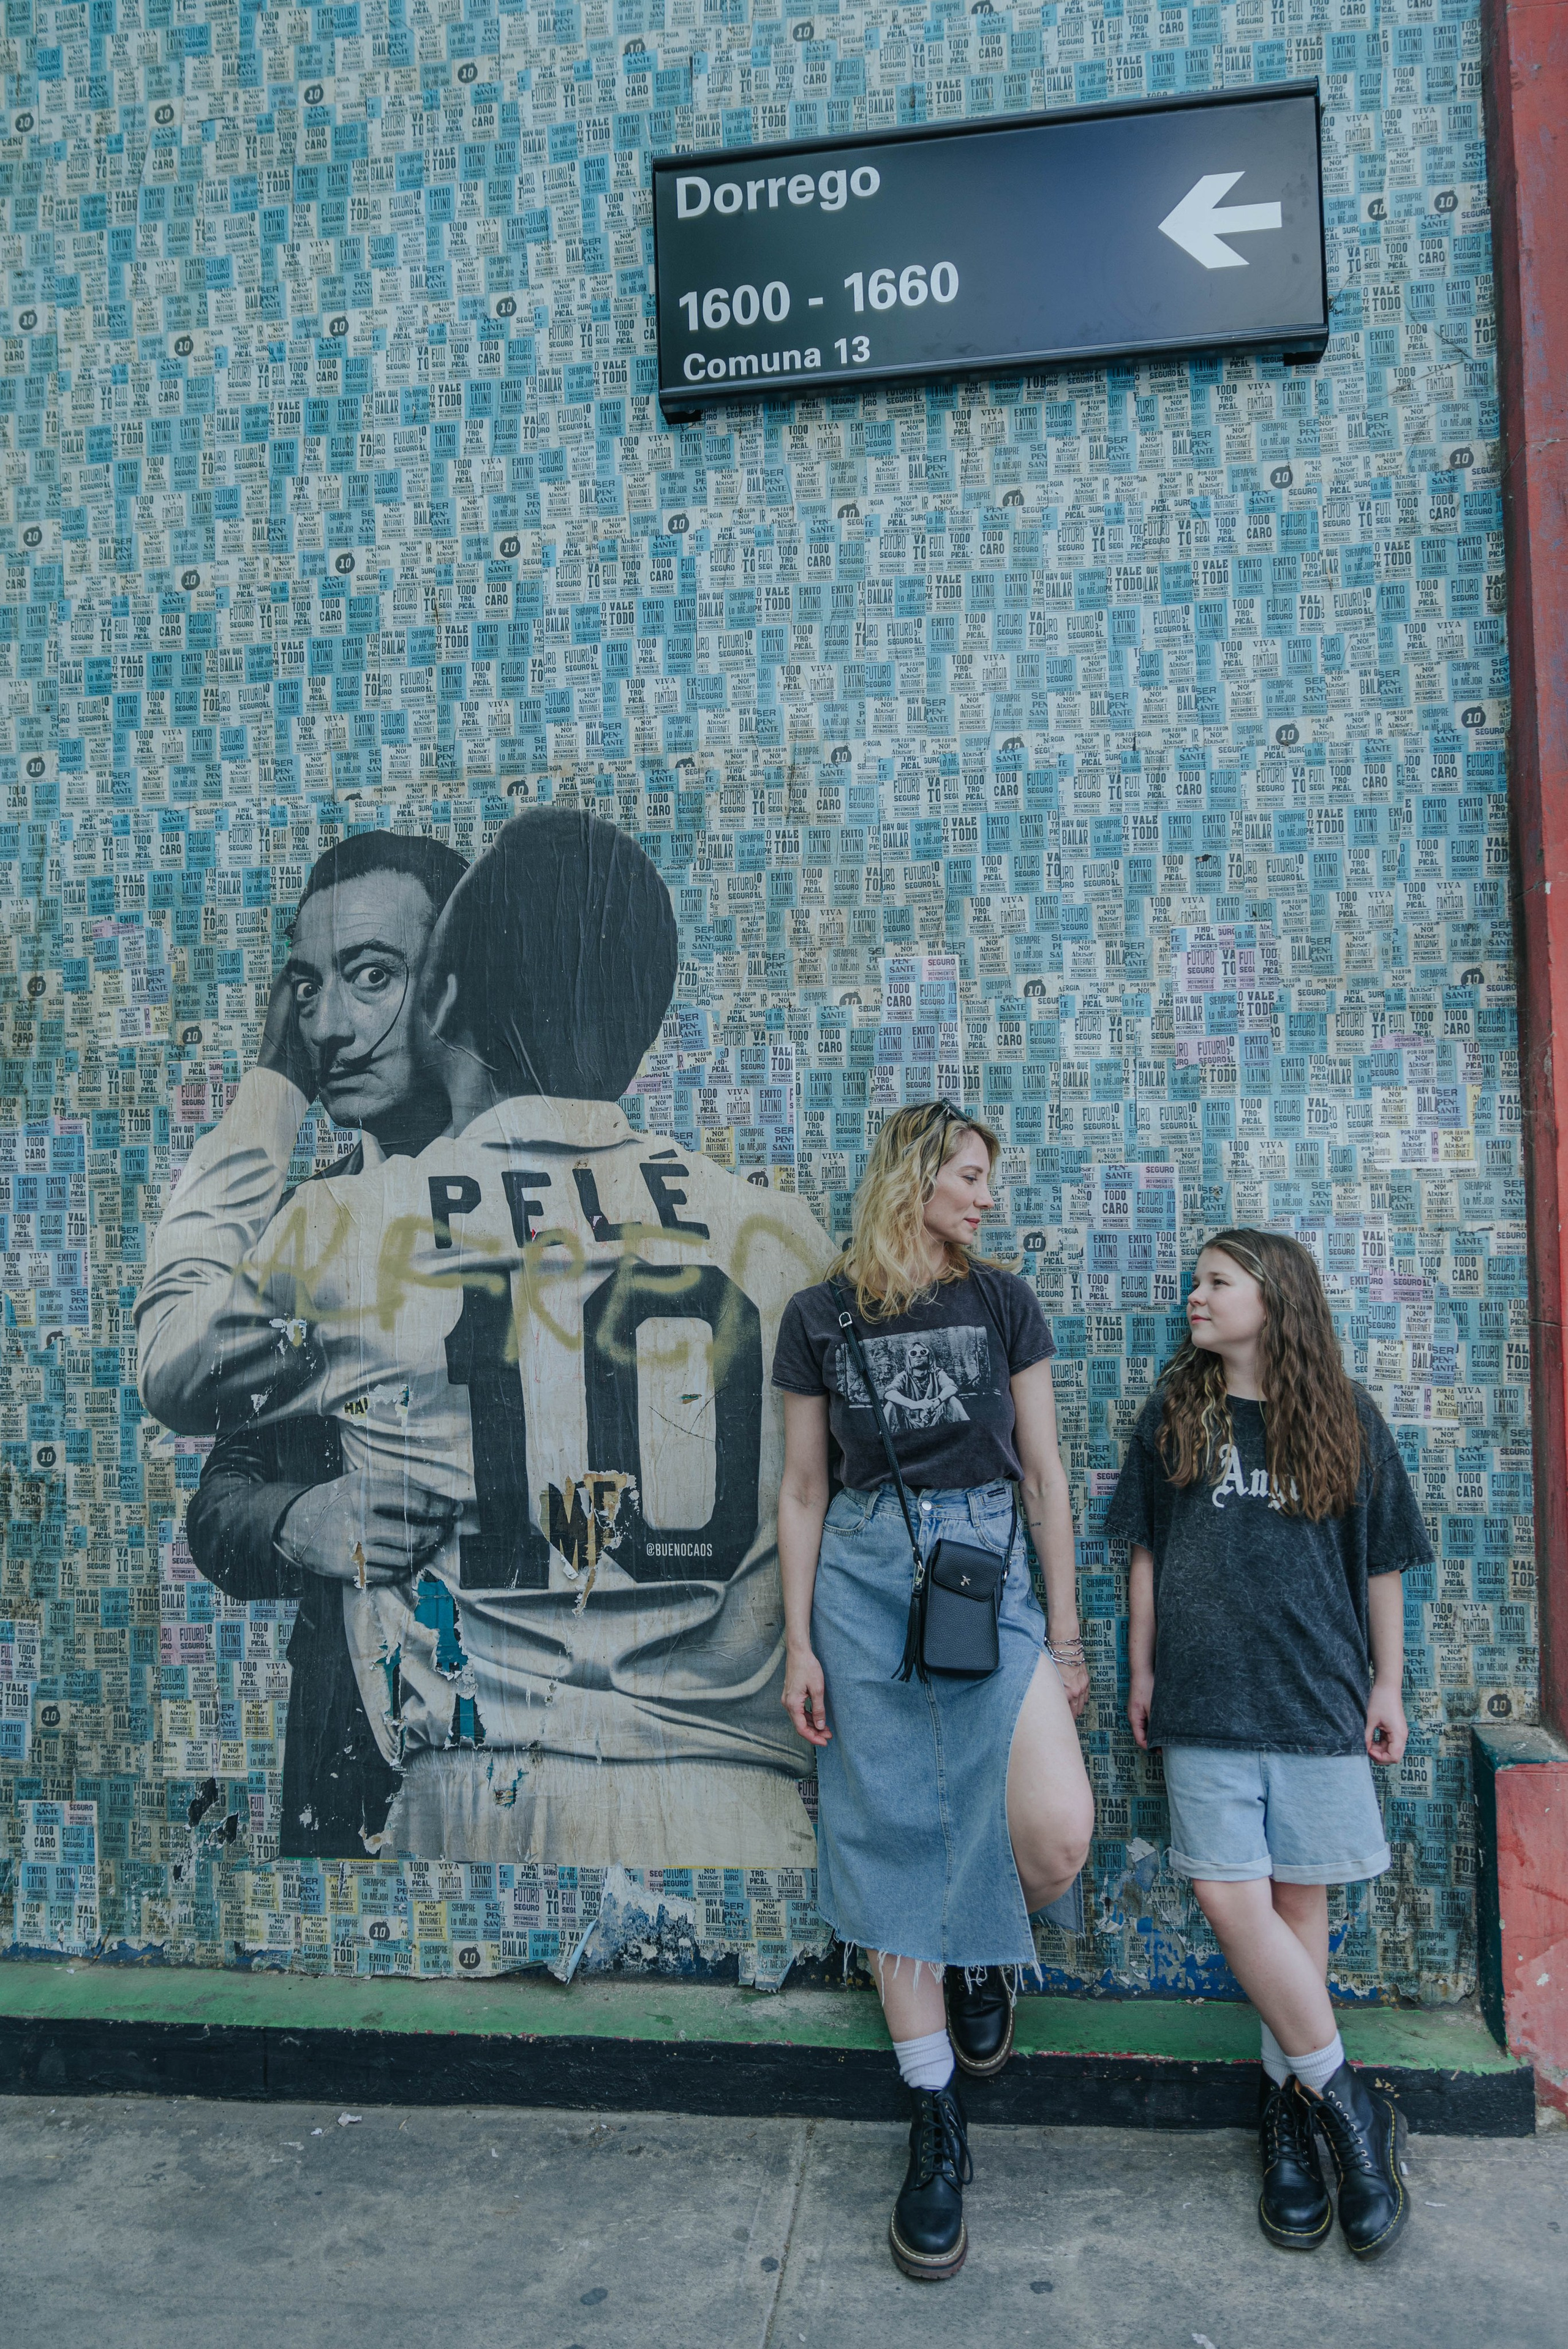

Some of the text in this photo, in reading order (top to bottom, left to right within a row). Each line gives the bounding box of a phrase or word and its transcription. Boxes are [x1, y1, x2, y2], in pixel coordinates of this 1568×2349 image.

[981, 36, 1000, 45] TODO
[979, 48, 1003, 58] CARO
[1393, 67, 1414, 77] TODO
[1004, 74, 1026, 83] EXITO
[937, 80, 960, 89] VALE
[1005, 85, 1027, 96] LATINO
[936, 92, 962, 104] TODO
[307, 128, 325, 138] TODO
[1346, 128, 1371, 141] FANTASIA
[305, 139, 326, 149] CARO
[433, 148, 454, 156] VALE
[400, 154, 422, 164] SIEMPRE
[433, 158, 456, 171] TODO
[466, 155, 485, 167] LATINO
[371, 167, 393, 179] BAILAR
[677, 165, 880, 220] Dorrego
[431, 198, 450, 209] LATINO
[1440, 197, 1452, 206] 10
[1420, 239, 1442, 249] TODO
[1419, 251, 1444, 263] CARO
[1410, 284, 1434, 293] EXITO
[679, 281, 790, 331] 1600
[844, 261, 959, 312] 1660
[684, 336, 870, 380] Comuna 13
[121, 432, 143, 443] TODO
[152, 430, 170, 441] LATINO
[817, 436, 841, 449] FANTASIA
[1275, 472, 1289, 483] 10
[1248, 516, 1269, 524] TODO
[26, 532, 39, 541] 10
[1247, 527, 1272, 538] CARO
[504, 542, 516, 551] 10
[809, 544, 829, 553] TODO
[808, 556, 831, 567] CARO
[1203, 560, 1228, 569] VALE
[1238, 559, 1261, 568] EXITO
[1202, 571, 1229, 584] TODO
[1239, 570, 1262, 582] LATINO
[488, 583, 506, 592] TODO
[486, 595, 508, 605] CARO
[868, 589, 892, 604] BAILAR
[610, 601, 633, 610] VALE
[643, 601, 663, 609] EXITO
[766, 598, 790, 610] TODO
[610, 612, 634, 625] TODO
[643, 611, 663, 622] LATINO
[546, 617, 570, 632] BAILAR
[1474, 620, 1498, 630] EXITO
[1475, 632, 1498, 644] LATINO
[1467, 713, 1481, 723] 10
[1433, 754, 1455, 764] TODO
[1431, 767, 1457, 778] CARO
[1020, 814, 1042, 823] EXITO
[1317, 809, 1343, 818] VALE
[1020, 825, 1043, 837] LATINO
[1316, 820, 1344, 832] TODO
[1062, 830, 1088, 845] BAILAR
[160, 844, 181, 854] CARO
[775, 841, 799, 853] TODO
[123, 884, 145, 896] TODO
[218, 881, 241, 894] BAILAR
[1001, 910, 1025, 922] FANTASIA
[889, 984, 909, 994] TODO
[887, 996, 911, 1007] CARO
[1176, 1006, 1202, 1022] BAILAR
[1444, 1023, 1469, 1034] CARO
[1210, 1069, 1236, 1082] TODO
[128, 1109, 149, 1117] VALE
[128, 1120, 150, 1131] TODO
[1295, 1143, 1318, 1152] EXITO
[25, 1149, 45, 1158] CARO
[429, 1149, 710, 1248] PELÉ
[1102, 1202, 1128, 1214] CARO
[1094, 1235, 1117, 1243] EXITO
[1479, 1303, 1503, 1311] EXITO
[1096, 1317, 1121, 1325] VALE
[1096, 1327, 1122, 1340] TODO
[444, 1264, 763, 1589] 10
[1457, 1487, 1482, 1497] CARO
[646, 1543, 712, 1556] @BUENOCAOS
[162, 1595, 184, 1609] BAILAR
[6, 1684, 28, 1692] VALE
[5, 1694, 28, 1706] TODO
[1493, 1700, 1506, 1710] 10
[44, 1712, 56, 1721] 10
[409, 1862, 428, 1871] TODO
[439, 1877, 462, 1888] FANTASIA
[374, 1928, 386, 1937] 10
